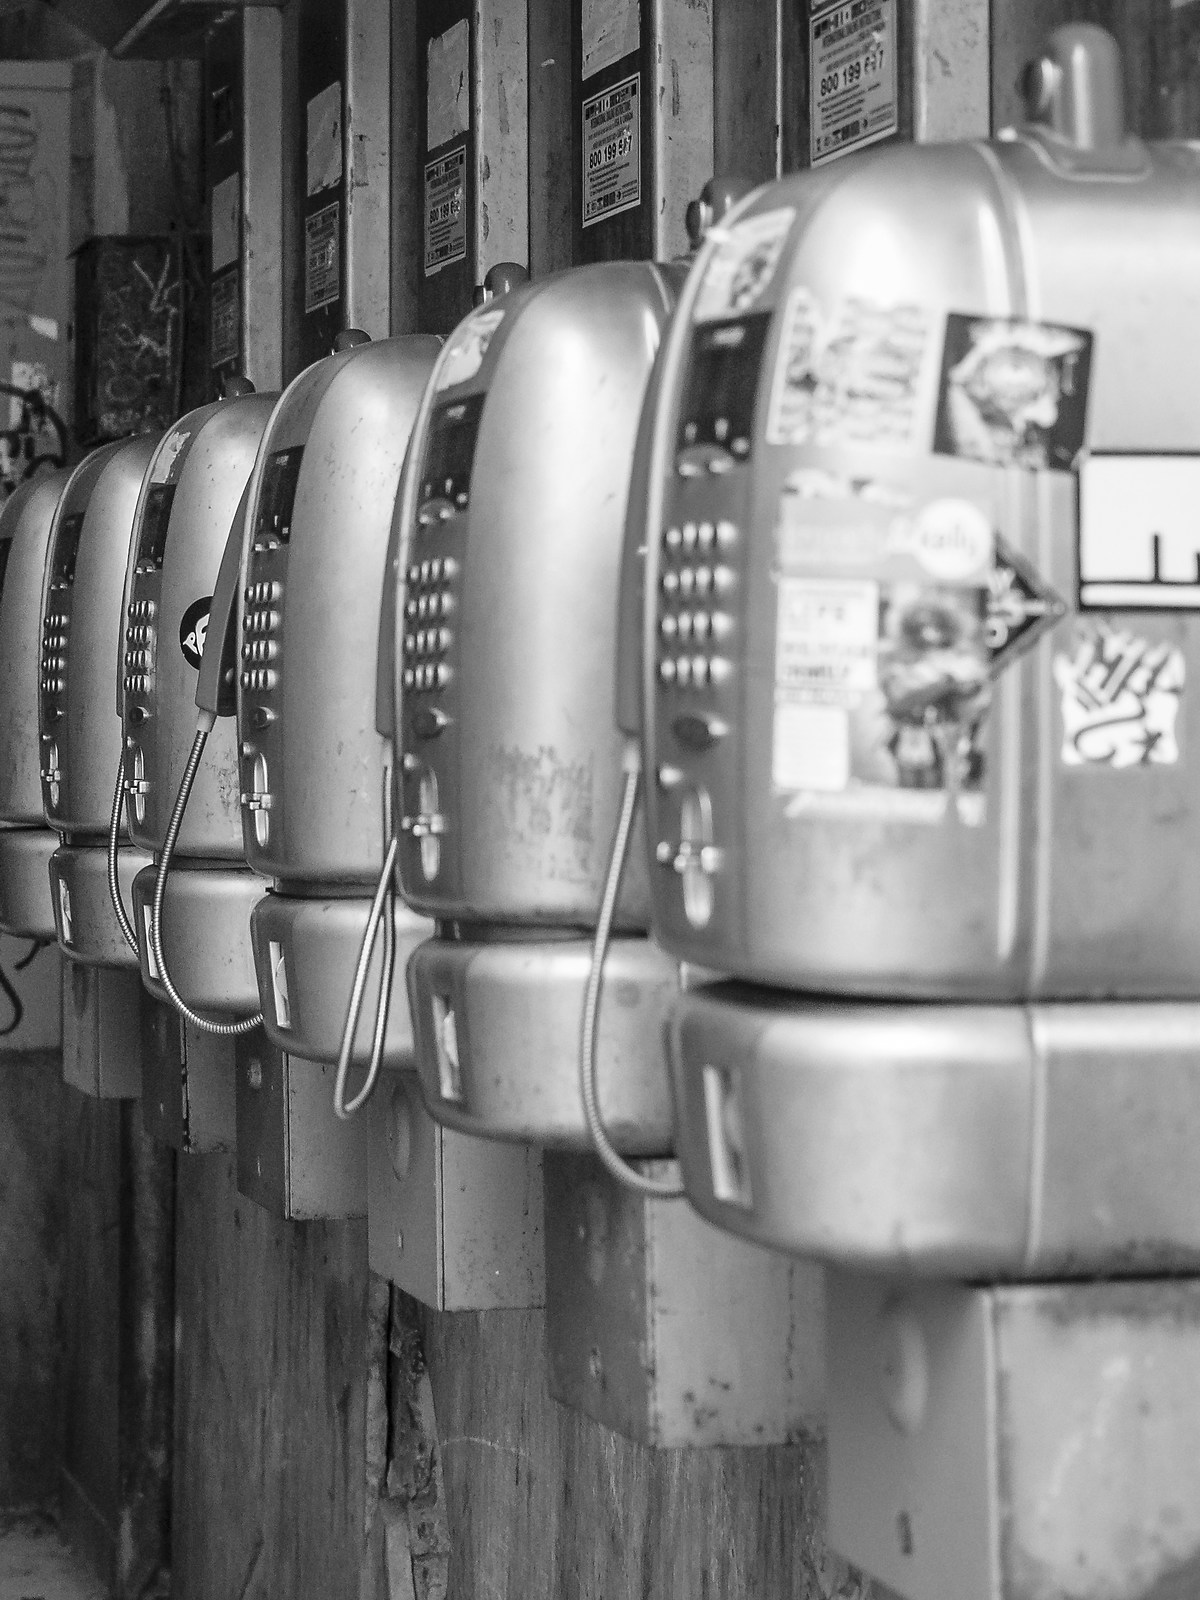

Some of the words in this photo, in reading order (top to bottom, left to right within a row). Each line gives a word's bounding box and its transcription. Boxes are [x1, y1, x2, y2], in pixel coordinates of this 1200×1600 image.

[820, 72, 839, 97] 800
[843, 61, 861, 86] 199
[589, 149, 602, 169] 800
[604, 142, 617, 161] 199
